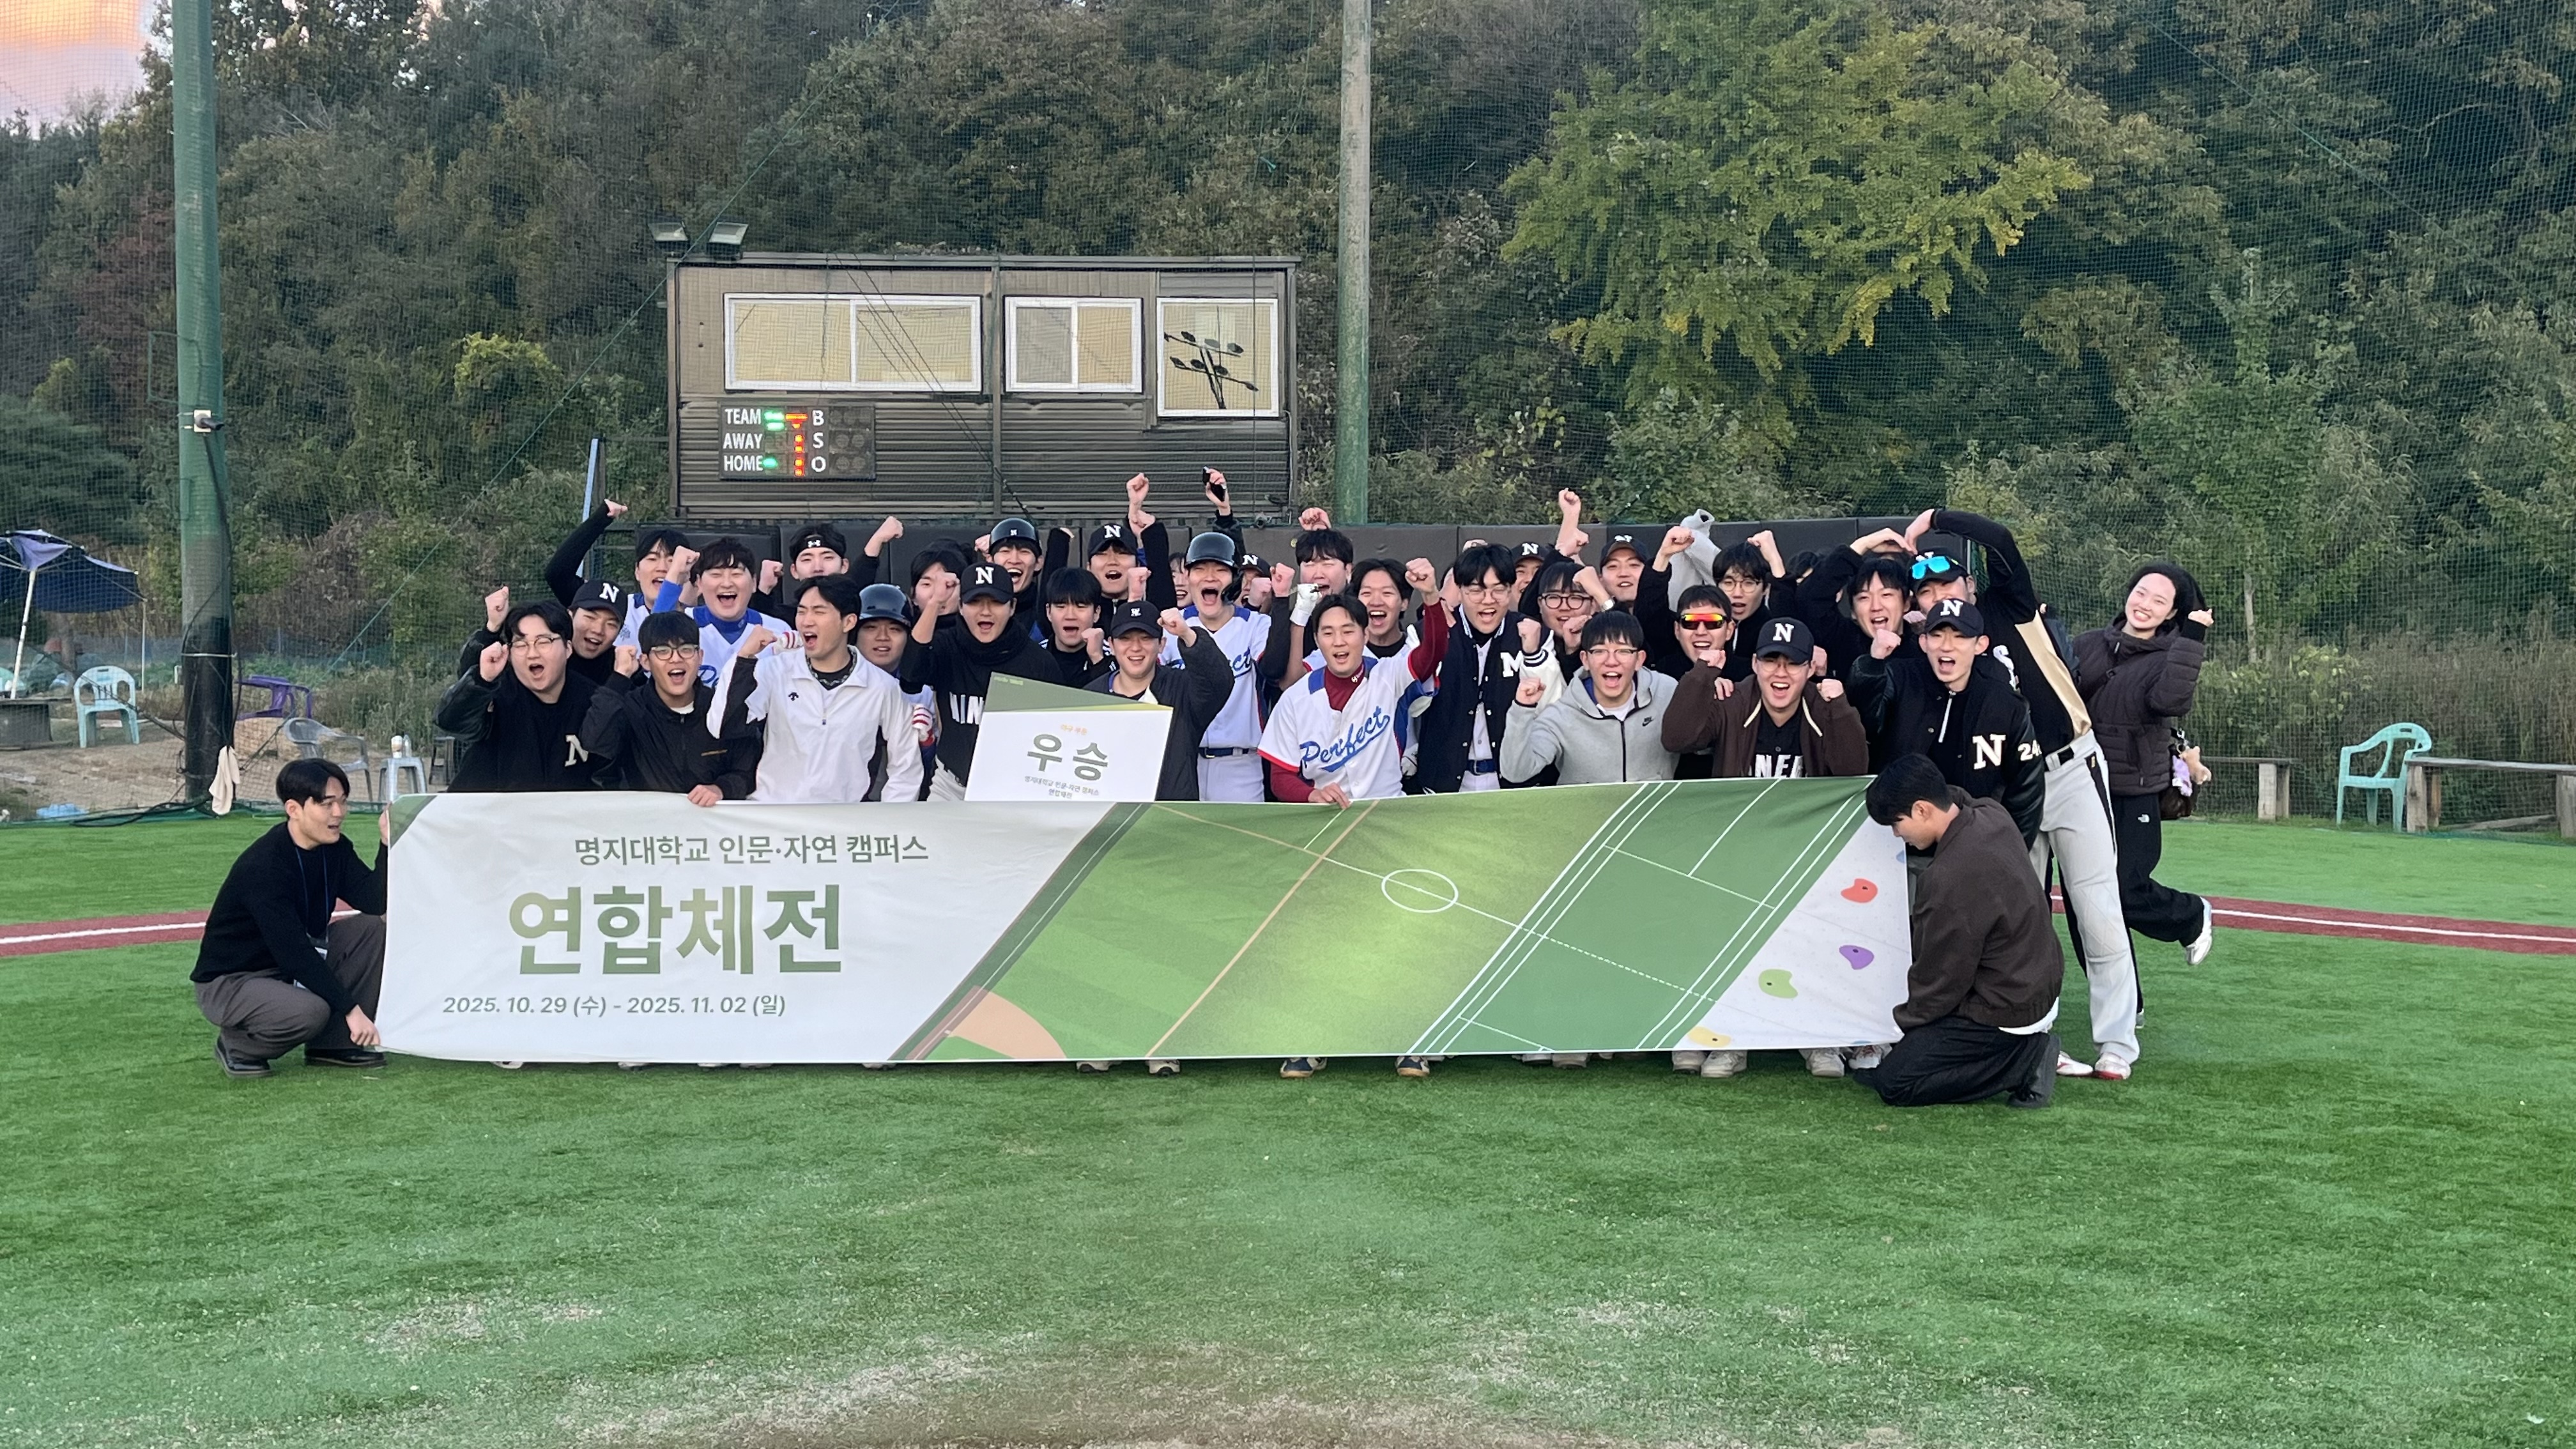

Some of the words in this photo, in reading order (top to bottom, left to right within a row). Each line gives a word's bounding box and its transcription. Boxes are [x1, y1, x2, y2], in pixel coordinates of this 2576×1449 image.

[724, 408, 762, 425] TEAM
[812, 410, 824, 426] B
[723, 433, 763, 449] AWAY
[813, 432, 824, 448] S
[723, 455, 763, 471] HOME
[811, 456, 826, 472] O
[1104, 525, 1121, 539] N
[1522, 542, 1538, 556] N
[1242, 555, 1259, 565] N
[975, 566, 995, 585] N
[599, 582, 620, 603] N
[1940, 599, 1963, 617] N
[1772, 623, 1795, 642] N
[1499, 650, 1524, 678] M
[1299, 705, 1391, 769] Perfect
[565, 734, 588, 767] N
[1027, 733, 1108, 781] 우승
[1972, 733, 2006, 770] N
[574, 836, 710, 866] 명지대학교
[719, 834, 838, 864] 인문·자연
[846, 834, 929, 863] 캠퍼스
[510, 884, 842, 975] 연합체전
[443, 997, 500, 1013] 2025.
[508, 997, 534, 1013] 10.
[540, 997, 567, 1013] 29
[574, 996, 606, 1018] (수)
[627, 997, 684, 1013] 2025.
[691, 997, 714, 1013] 11.
[720, 997, 746, 1013] 02
[753, 995, 785, 1017] (일)
